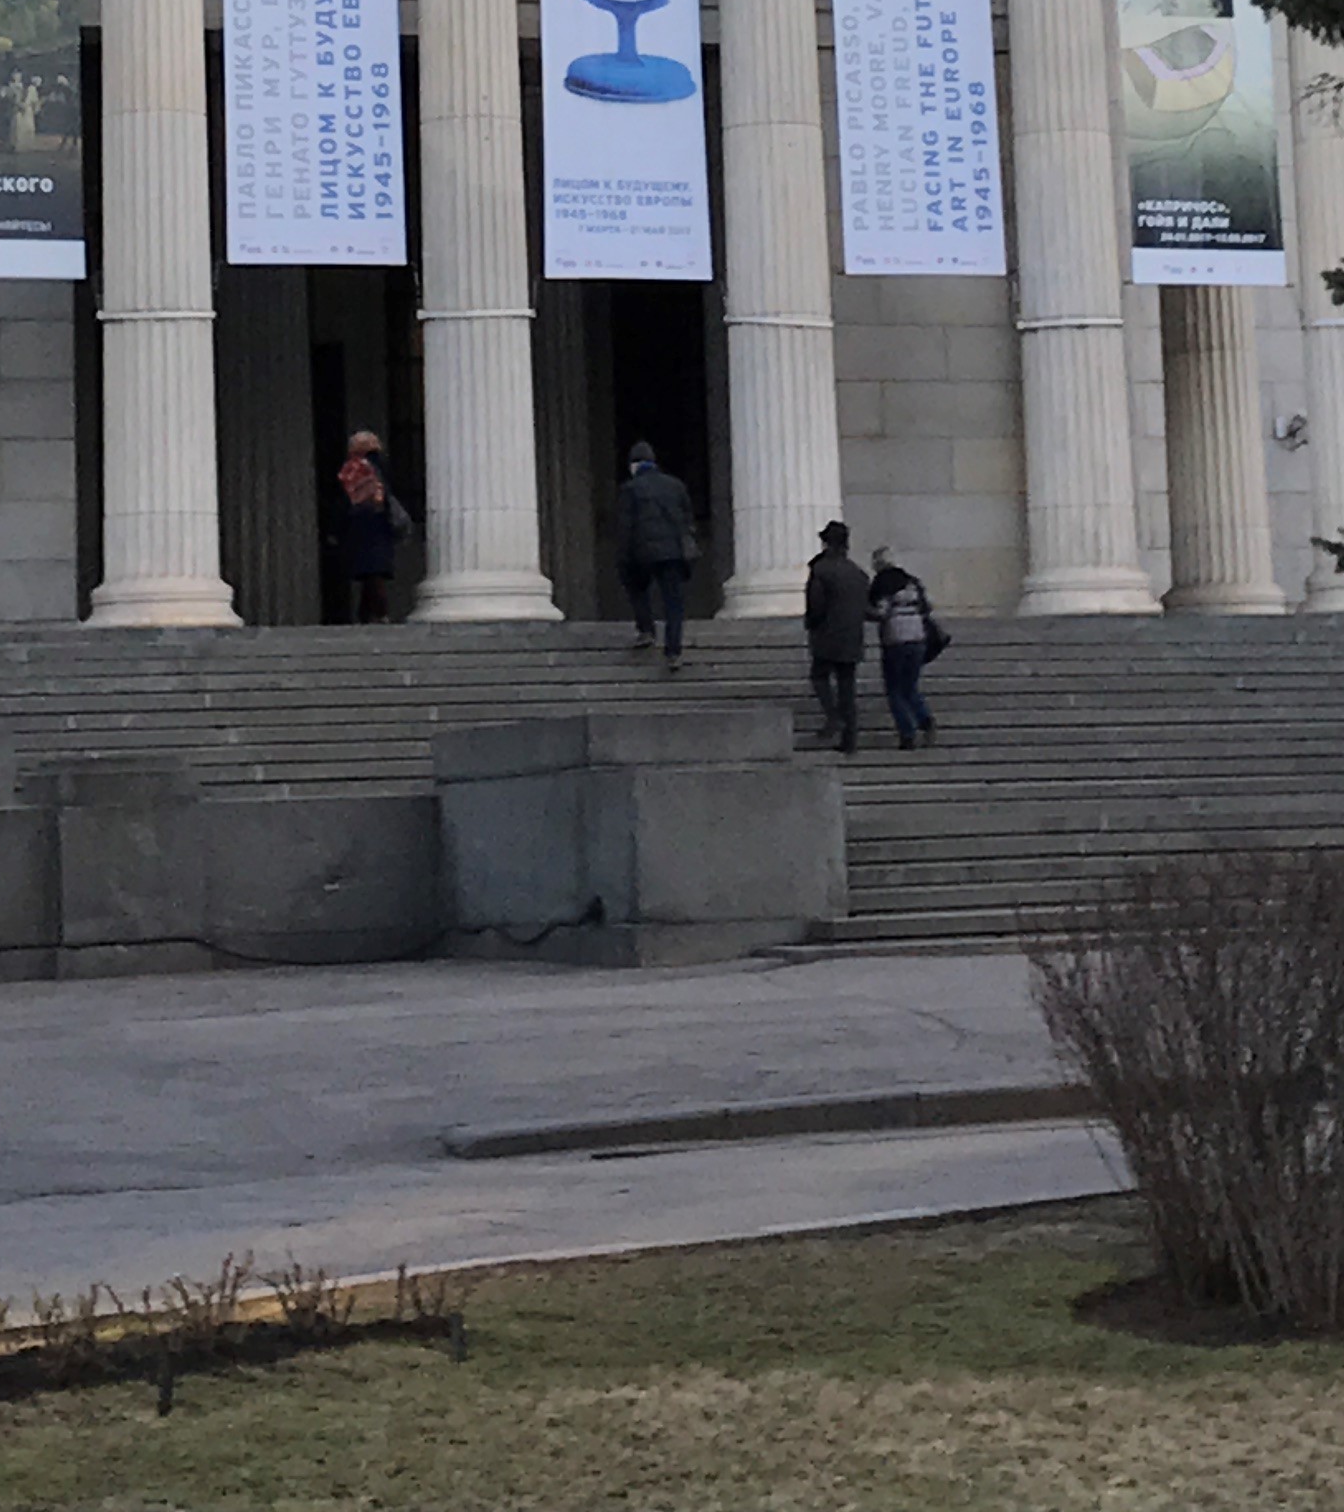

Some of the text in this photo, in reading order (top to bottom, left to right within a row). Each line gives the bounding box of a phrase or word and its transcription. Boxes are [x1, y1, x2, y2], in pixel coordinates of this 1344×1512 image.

[317, 81, 336, 99] К
[841, 7, 864, 131] PICASSO,
[891, 6, 913, 109] FREUD,
[918, 62, 937, 116] THE
[237, 122, 257, 220] ПАБЛО
[264, 115, 284, 220] ГЕНРИ
[290, 111, 312, 220] РЕНАТО
[318, 113, 342, 220] ЛИЦОМ
[343, 44, 366, 220] ИСКУССТВО
[939, 10, 969, 232] ART IN EUROPE
[848, 142, 870, 232] PABLO
[873, 144, 895, 232] HENRY
[898, 124, 919, 232] LUCIAN
[921, 129, 944, 233] FACING
